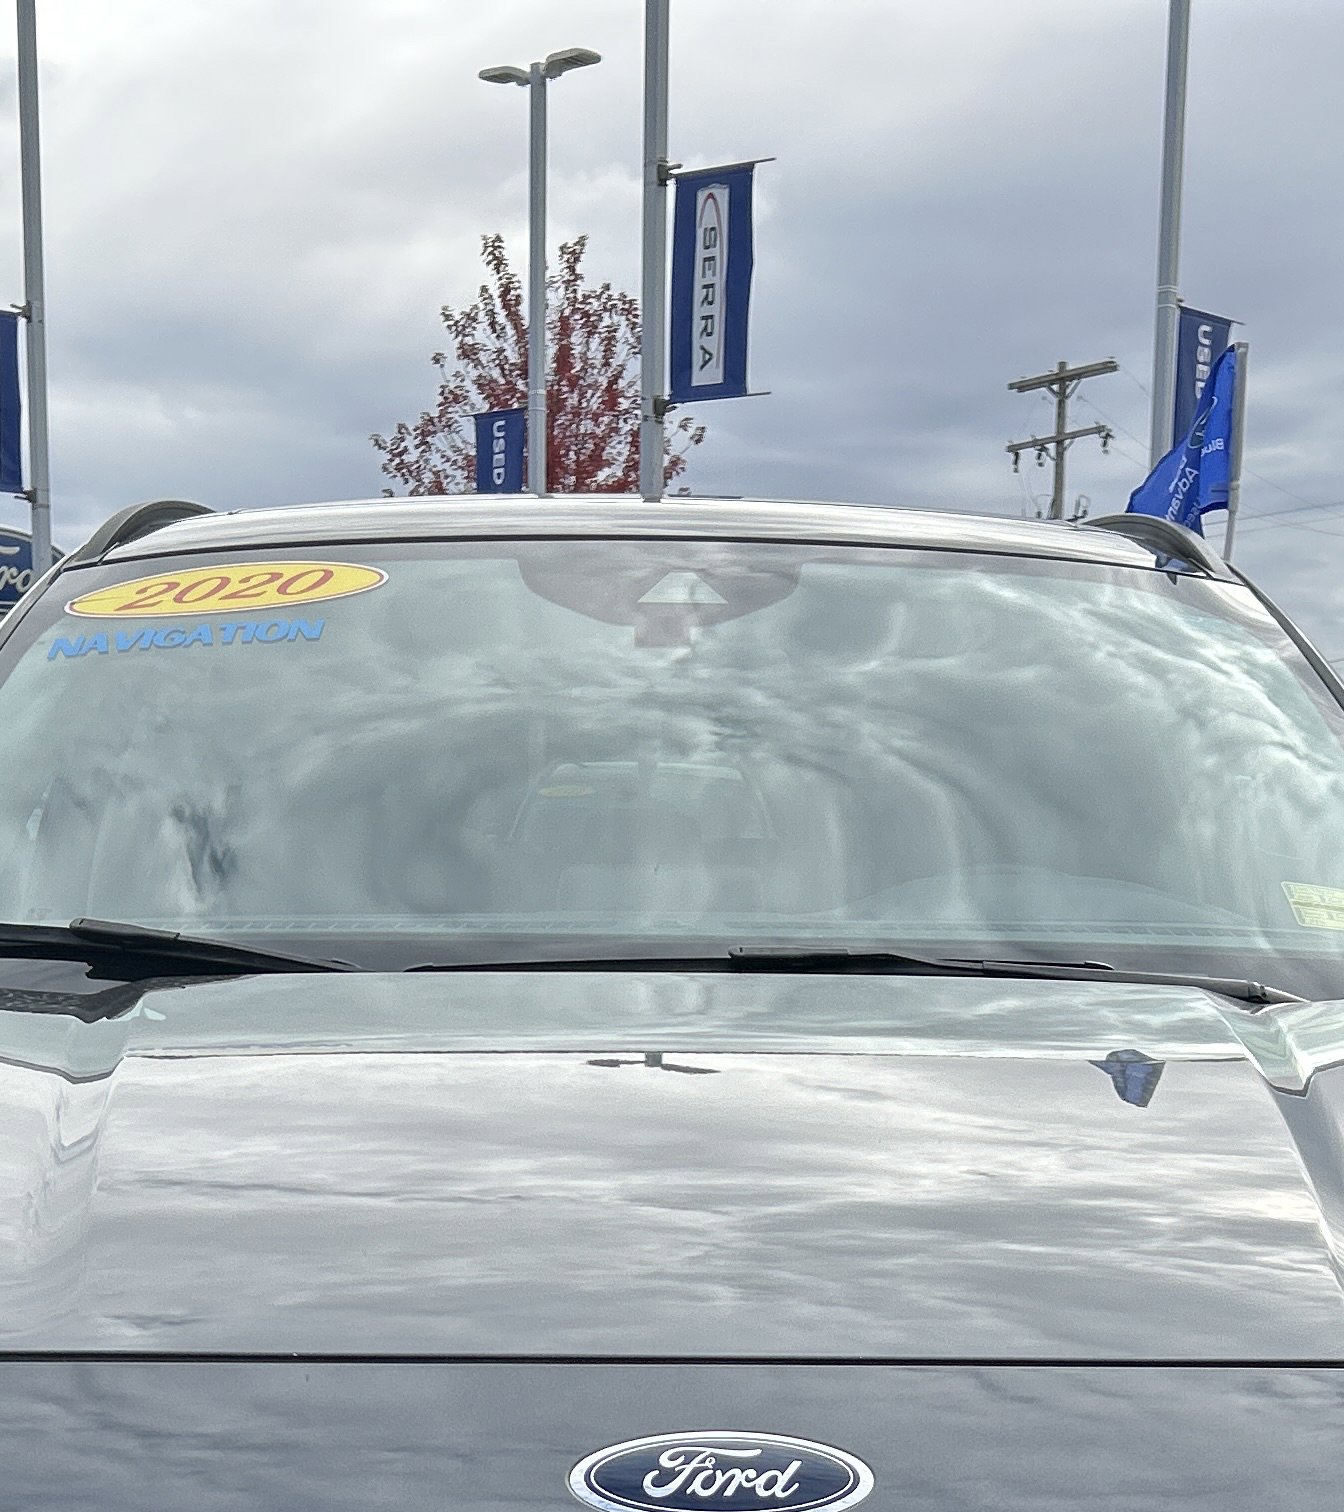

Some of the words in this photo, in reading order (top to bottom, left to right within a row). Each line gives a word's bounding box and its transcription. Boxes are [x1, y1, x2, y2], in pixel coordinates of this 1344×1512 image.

[699, 226, 717, 371] SERRA
[492, 420, 506, 485] USED
[114, 568, 335, 611] 2020
[47, 618, 326, 661] NAVIGATION
[642, 1446, 802, 1497] Ford
